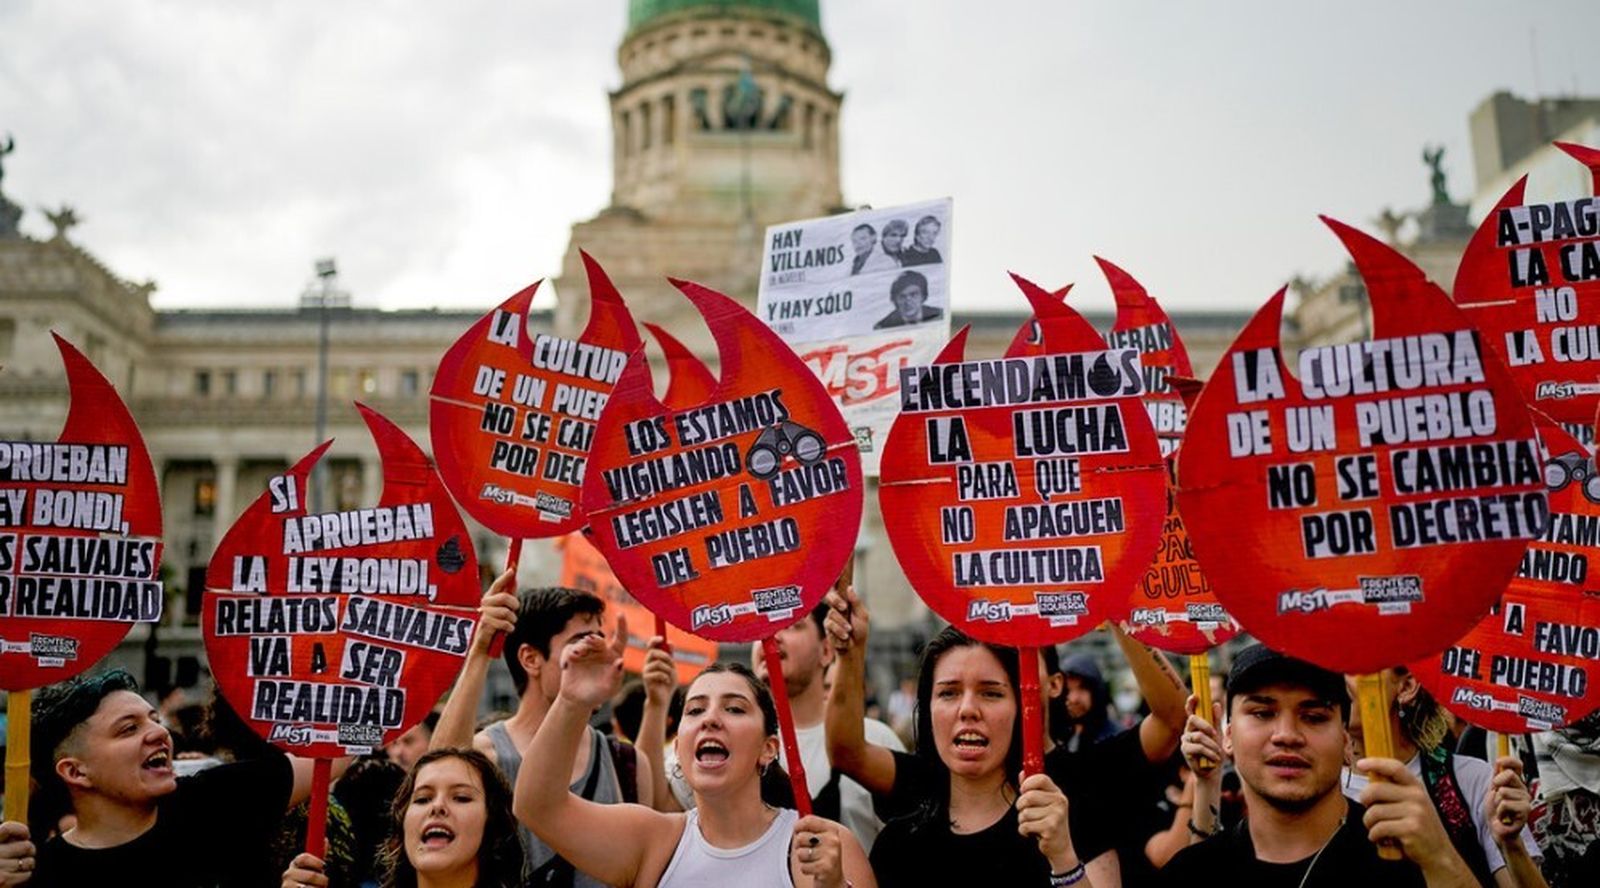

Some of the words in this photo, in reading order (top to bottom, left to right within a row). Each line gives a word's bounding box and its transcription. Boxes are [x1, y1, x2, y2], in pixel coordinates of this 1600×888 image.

[771, 245, 844, 272] VILLANOS
[772, 229, 802, 250] HAY
[1509, 248, 1550, 286] LA
[767, 303, 778, 321] Y
[780, 297, 813, 319] HAY
[815, 291, 852, 316] SÓLO
[1535, 287, 1578, 323] NO
[487, 309, 520, 348] LA
[1505, 329, 1544, 367] LA
[473, 365, 506, 399] DE
[512, 374, 547, 409] UN
[807, 351, 912, 401] MST
[1232, 348, 1285, 403] LA
[1300, 330, 1485, 400] CULTURA
[1540, 383, 1574, 398] MST
[481, 402, 517, 436] NO
[522, 411, 550, 443] SE
[624, 415, 671, 457] LOS
[675, 389, 788, 446] ESTAMOS
[928, 418, 971, 462] LA
[1014, 407, 1127, 456] LUCHA
[1227, 411, 1273, 457] DE
[1285, 405, 1336, 453] UN
[1356, 389, 1496, 447] PUEBLO
[491, 441, 538, 476] POR
[604, 443, 741, 501] VIGILANDO
[1269, 464, 1316, 508] NO
[1338, 456, 1379, 499] SE
[1393, 441, 1541, 493] CAMBIA
[269, 475, 298, 513] SI
[484, 487, 514, 504] MST
[959, 463, 1018, 500] PARA
[1035, 459, 1080, 500] QUE
[32, 489, 129, 537] BONDI,
[613, 491, 724, 549] LEGISLEN
[740, 484, 757, 518] A
[769, 458, 848, 507] FAVOR
[942, 507, 974, 542] NO
[1005, 500, 1123, 540] APAGUEN
[283, 503, 434, 555] APRUEBAN
[1303, 510, 1376, 557] POR
[1390, 492, 1549, 549] DECRETO
[1549, 514, 1600, 546] TAM
[24, 536, 154, 578] SALVAJES
[652, 548, 698, 587] DEL
[705, 518, 800, 567] PUEBLO
[955, 553, 983, 586] LA
[991, 548, 1102, 584] CULTURA
[16, 577, 161, 621] REALIDAD
[232, 556, 267, 592] LA
[287, 557, 338, 593] LEY
[341, 559, 437, 601] BONDI,
[1363, 579, 1404, 589] FRENTE
[694, 605, 731, 625] MST
[971, 602, 1009, 619] MST
[1134, 610, 1165, 624] MST
[1281, 591, 1327, 612] MST
[1507, 604, 1523, 633] A
[217, 597, 337, 634] RELATOS
[341, 597, 474, 655] SALVAJES
[250, 638, 290, 676] VA
[312, 643, 327, 673] A
[343, 641, 402, 687] SER
[1442, 648, 1482, 680] DEL
[1490, 655, 1587, 697] PUEBLO
[254, 681, 404, 728] REALIDAD
[1456, 691, 1492, 709] MST
[273, 725, 311, 744] MST
